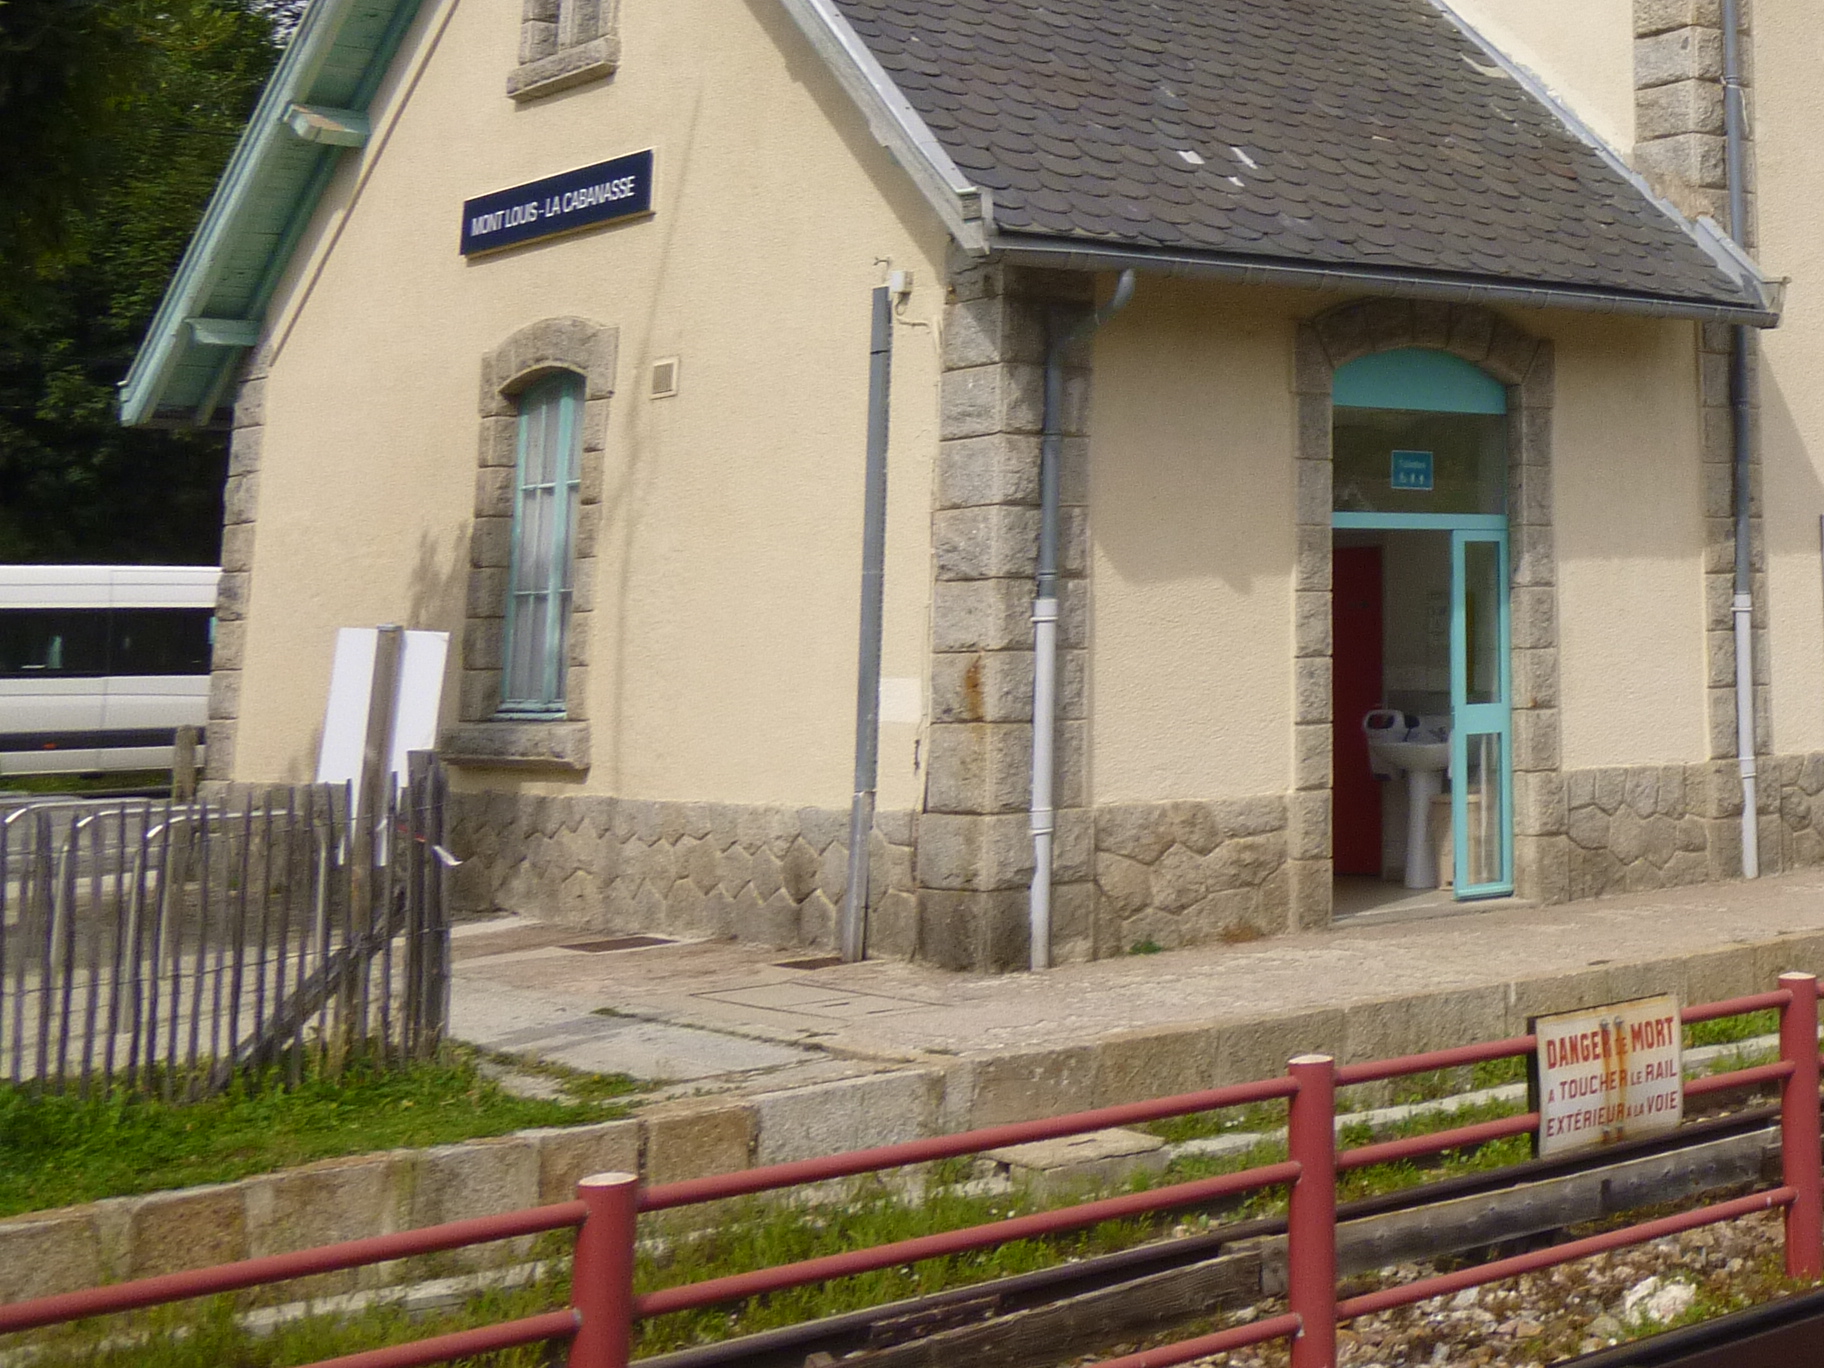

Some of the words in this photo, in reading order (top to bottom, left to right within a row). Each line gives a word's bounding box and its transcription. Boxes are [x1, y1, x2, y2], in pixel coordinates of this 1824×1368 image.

[471, 211, 505, 237] MONT
[505, 201, 538, 228] LOUIS
[545, 195, 560, 218] LA
[562, 175, 636, 212] CABANASSE
[1547, 1027, 1611, 1069] DANGER
[1630, 1016, 1674, 1052] MORT
[1560, 1069, 1628, 1100] TOUCHER
[1631, 1070, 1643, 1086] LE
[1645, 1059, 1678, 1080] RAIL
[1547, 1102, 1625, 1138] EXTÉRIEUR
[1634, 1103, 1645, 1117] LA
[1647, 1091, 1679, 1114] VOIE
